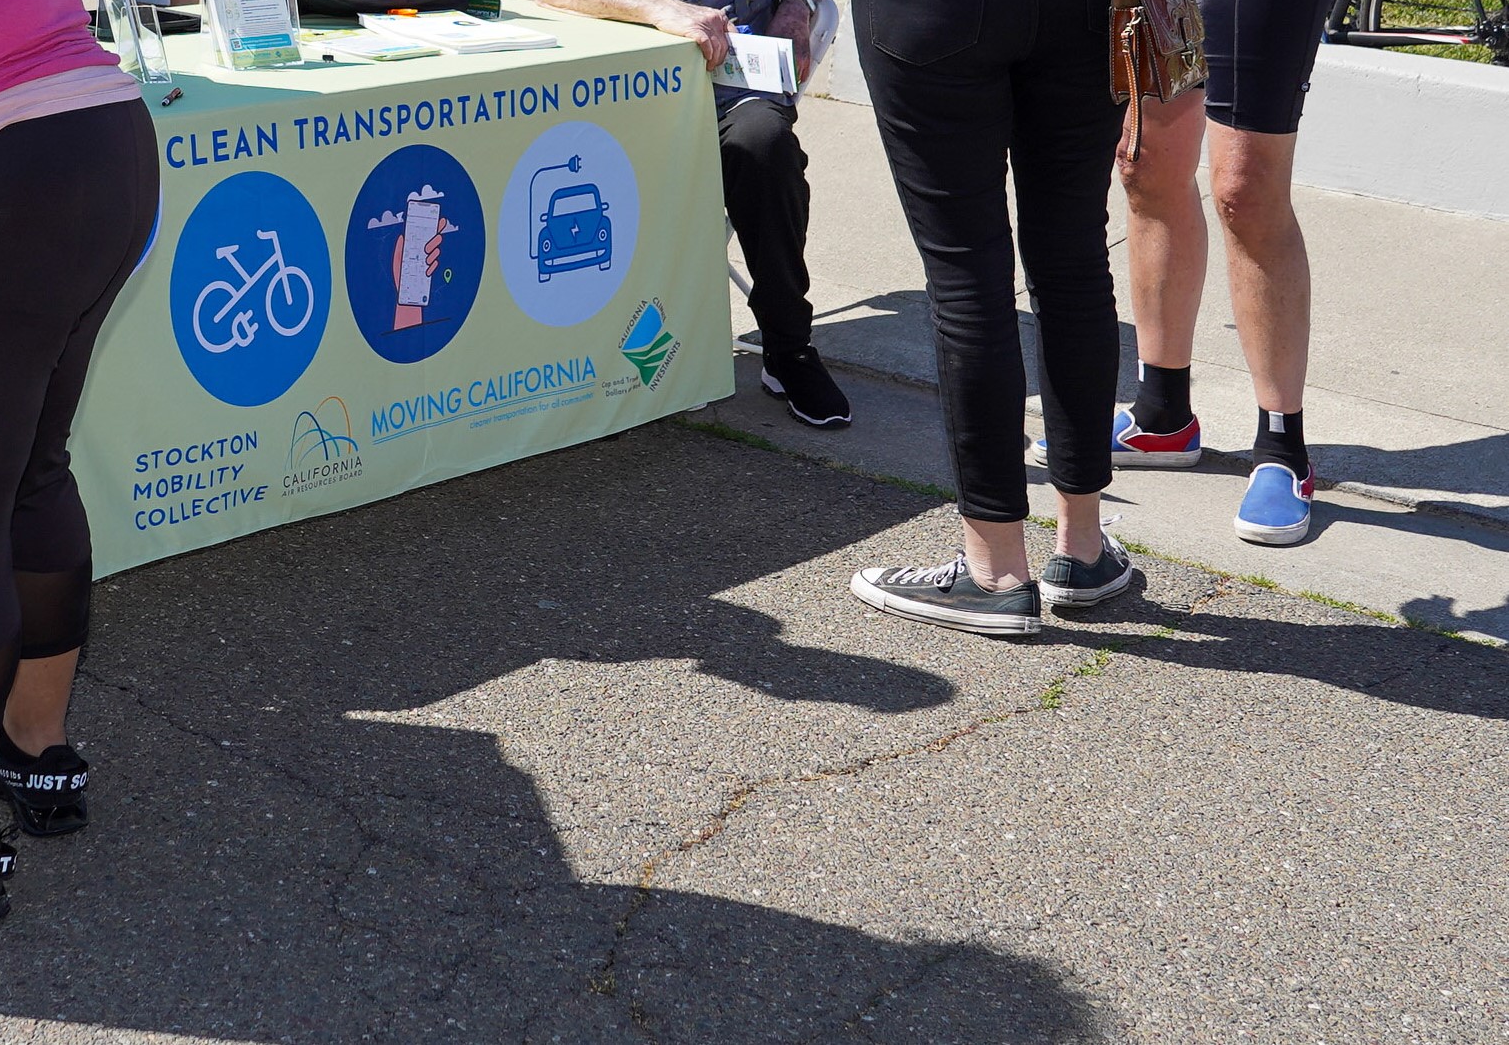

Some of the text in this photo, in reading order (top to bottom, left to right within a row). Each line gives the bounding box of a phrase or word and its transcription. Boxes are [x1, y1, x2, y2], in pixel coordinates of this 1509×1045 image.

[165, 65, 683, 169] CLEAN TRANSPORTATION OPTIONS
[618, 299, 648, 349] CALIFORNIA
[649, 340, 681, 392] INVESTMENTS
[371, 355, 597, 438] MOVING CALIFORNIA
[538, 401, 549, 411] for
[135, 430, 258, 473] STOCKTON
[283, 455, 362, 488] CALIFORNIA
[133, 463, 244, 501] MOBILITY
[281, 469, 363, 498] AIR RESOURCES BOARD
[135, 485, 269, 531] COLLECTIVE
[26, 773, 68, 791] JUST
